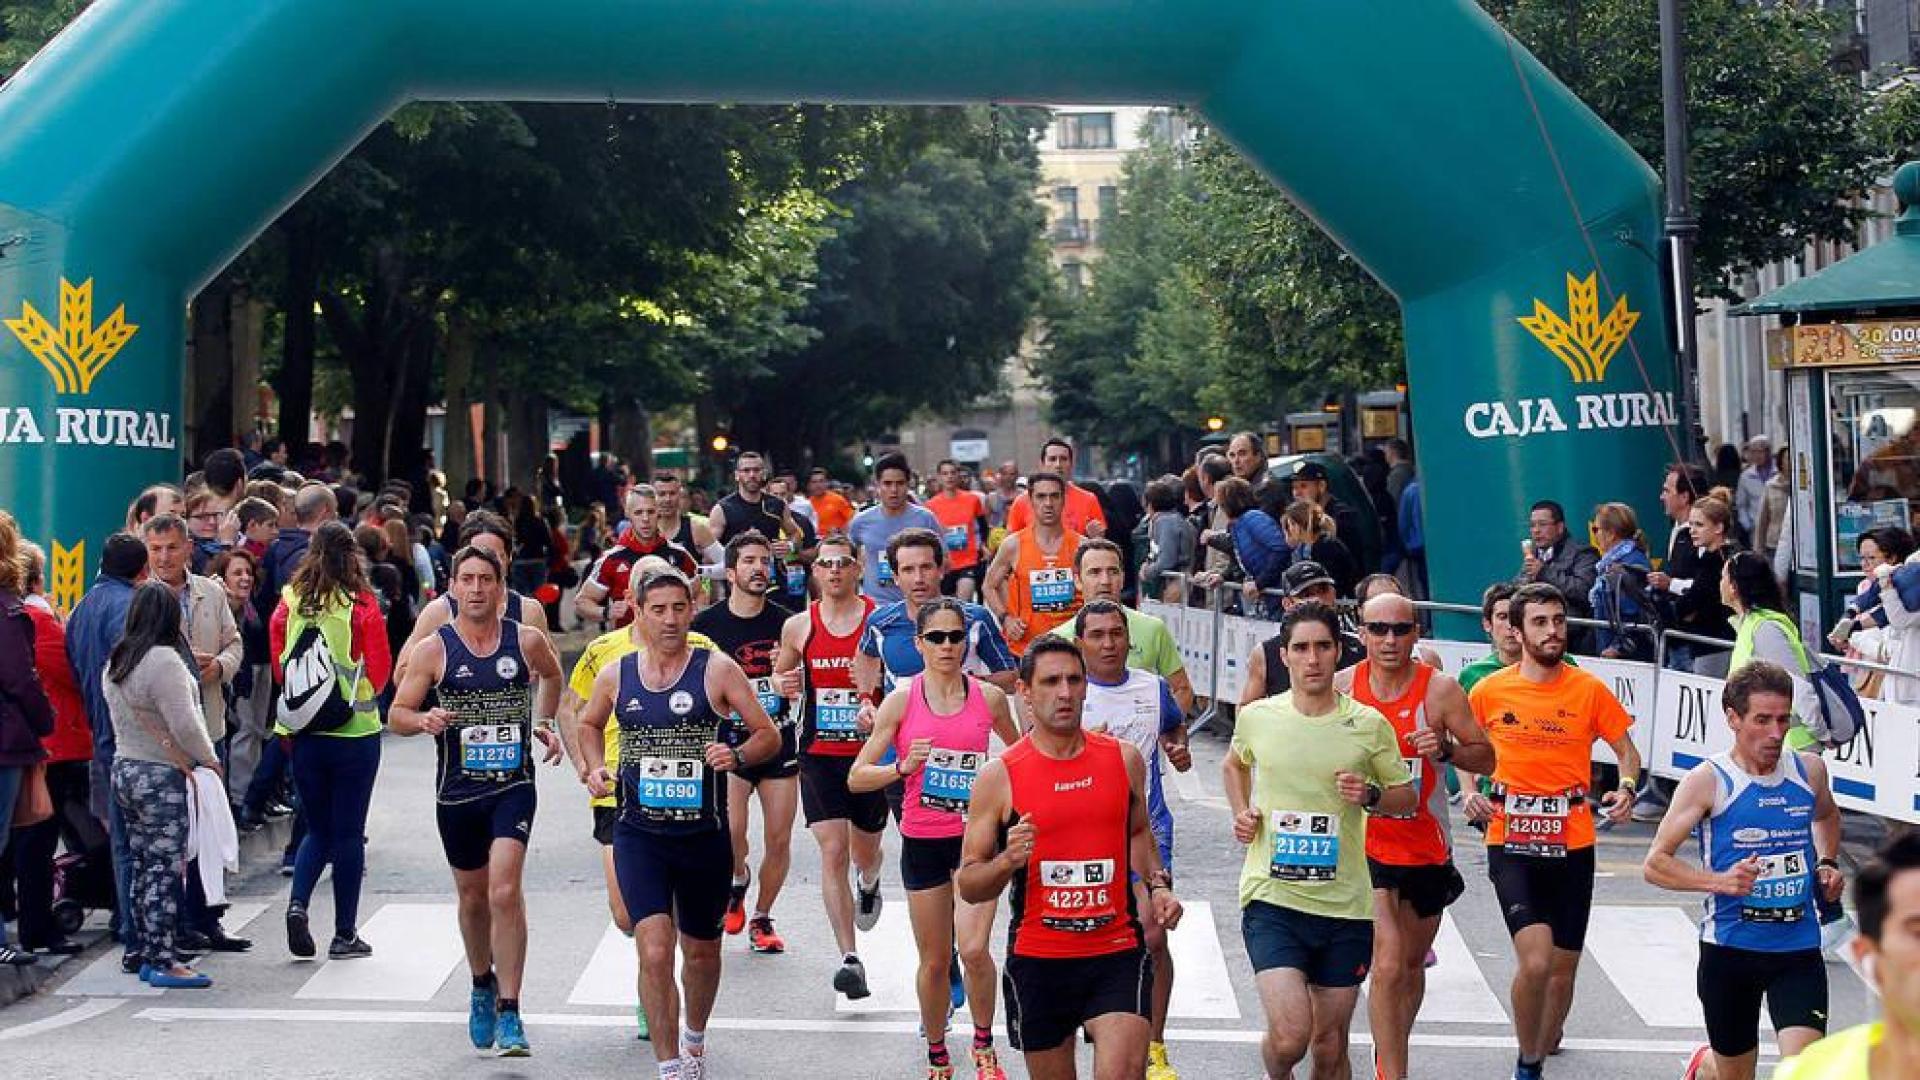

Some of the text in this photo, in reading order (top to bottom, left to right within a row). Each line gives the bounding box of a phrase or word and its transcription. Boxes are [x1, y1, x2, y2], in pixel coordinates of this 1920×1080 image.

[1465, 391, 1680, 438] CAJA RURAL
[55, 407, 176, 450] RURAL
[1675, 684, 1712, 745] DN
[644, 781, 697, 799] 21690
[1509, 817, 1562, 835] 42039
[1276, 836, 1332, 857] 21217
[1048, 889, 1108, 909] 42216
